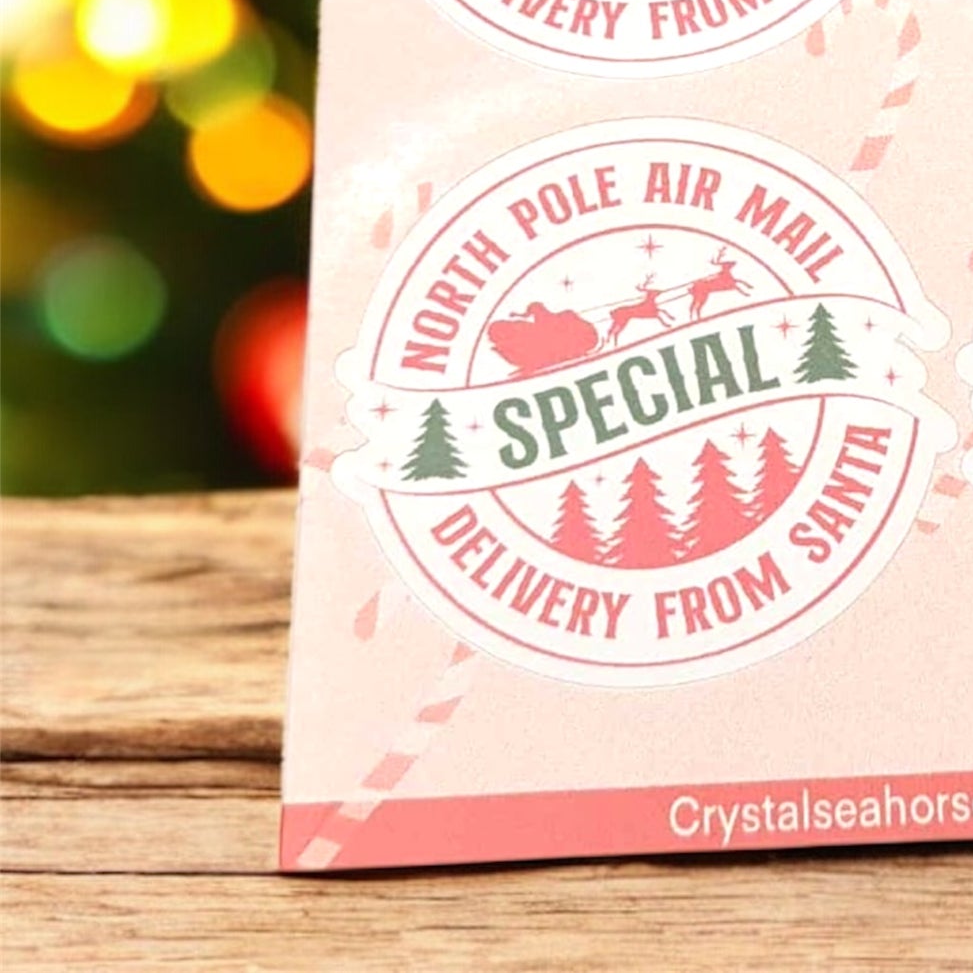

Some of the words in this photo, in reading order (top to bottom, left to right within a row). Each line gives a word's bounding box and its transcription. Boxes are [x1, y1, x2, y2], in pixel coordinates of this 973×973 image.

[400, 230, 510, 374] NORTH
[507, 165, 621, 240] POLE
[644, 162, 722, 211] AIR
[736, 185, 844, 284] MAIL
[492, 325, 781, 469] SPECIAL
[430, 504, 631, 639] DELIVERY
[654, 551, 792, 639] FROM
[788, 423, 893, 563] SANTA
